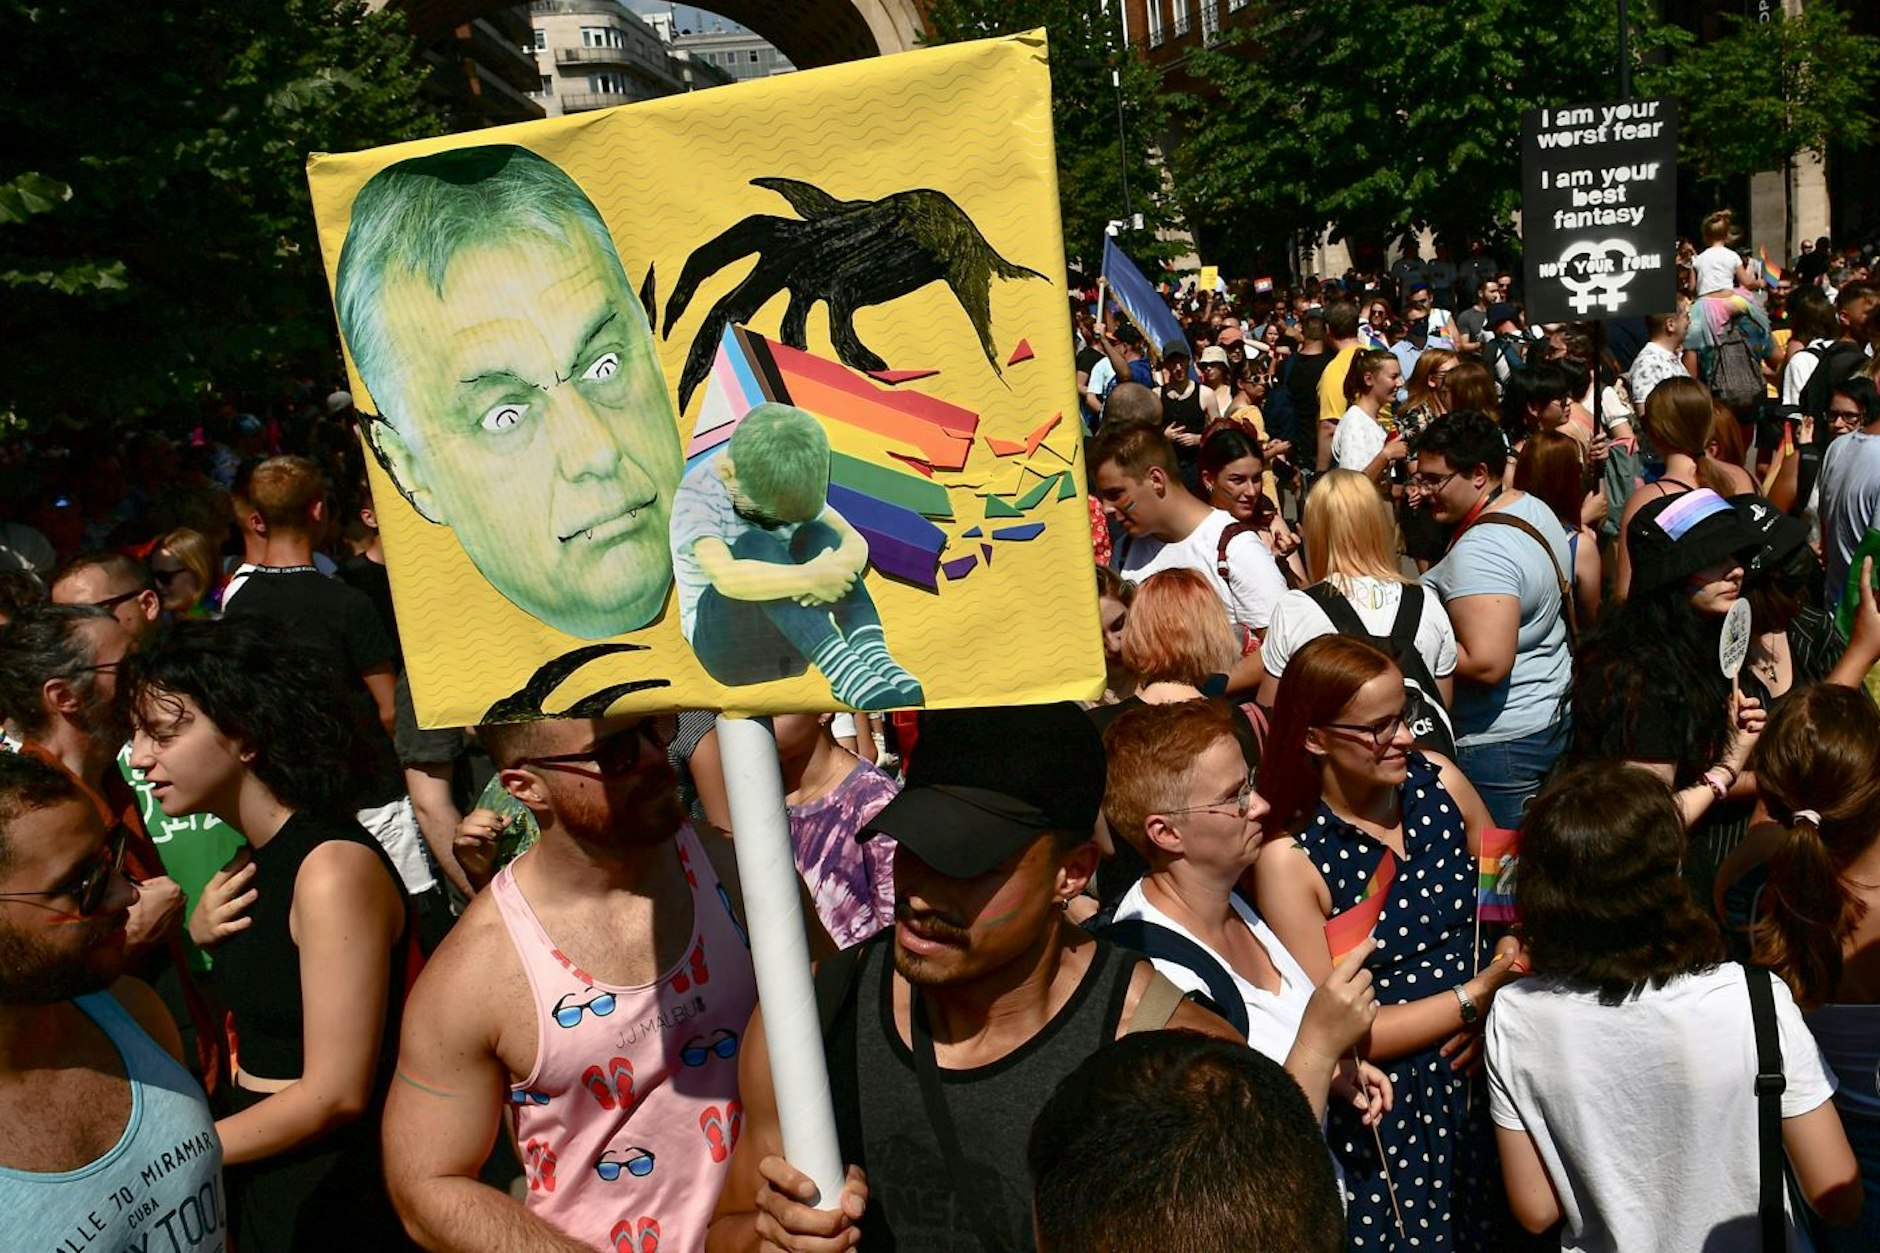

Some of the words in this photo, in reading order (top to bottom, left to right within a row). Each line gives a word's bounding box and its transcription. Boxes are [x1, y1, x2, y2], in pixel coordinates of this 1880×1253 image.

[1542, 109, 1549, 128] I
[1556, 108, 1594, 127] am
[1601, 101, 1660, 126] your
[1537, 124, 1609, 149] worst
[1613, 120, 1664, 141] fear
[1541, 171, 1549, 189] I
[1555, 168, 1593, 188] am
[1601, 163, 1660, 187] your
[1572, 184, 1627, 207] best
[1553, 205, 1646, 229] fantasy
[1538, 261, 1567, 278] NOT
[1573, 257, 1614, 275] YOUR
[1622, 253, 1661, 270] FORM
[109, 1186, 135, 1211] 70
[140, 1131, 214, 1188] MIRAMAR
[127, 1197, 160, 1230] CUBA
